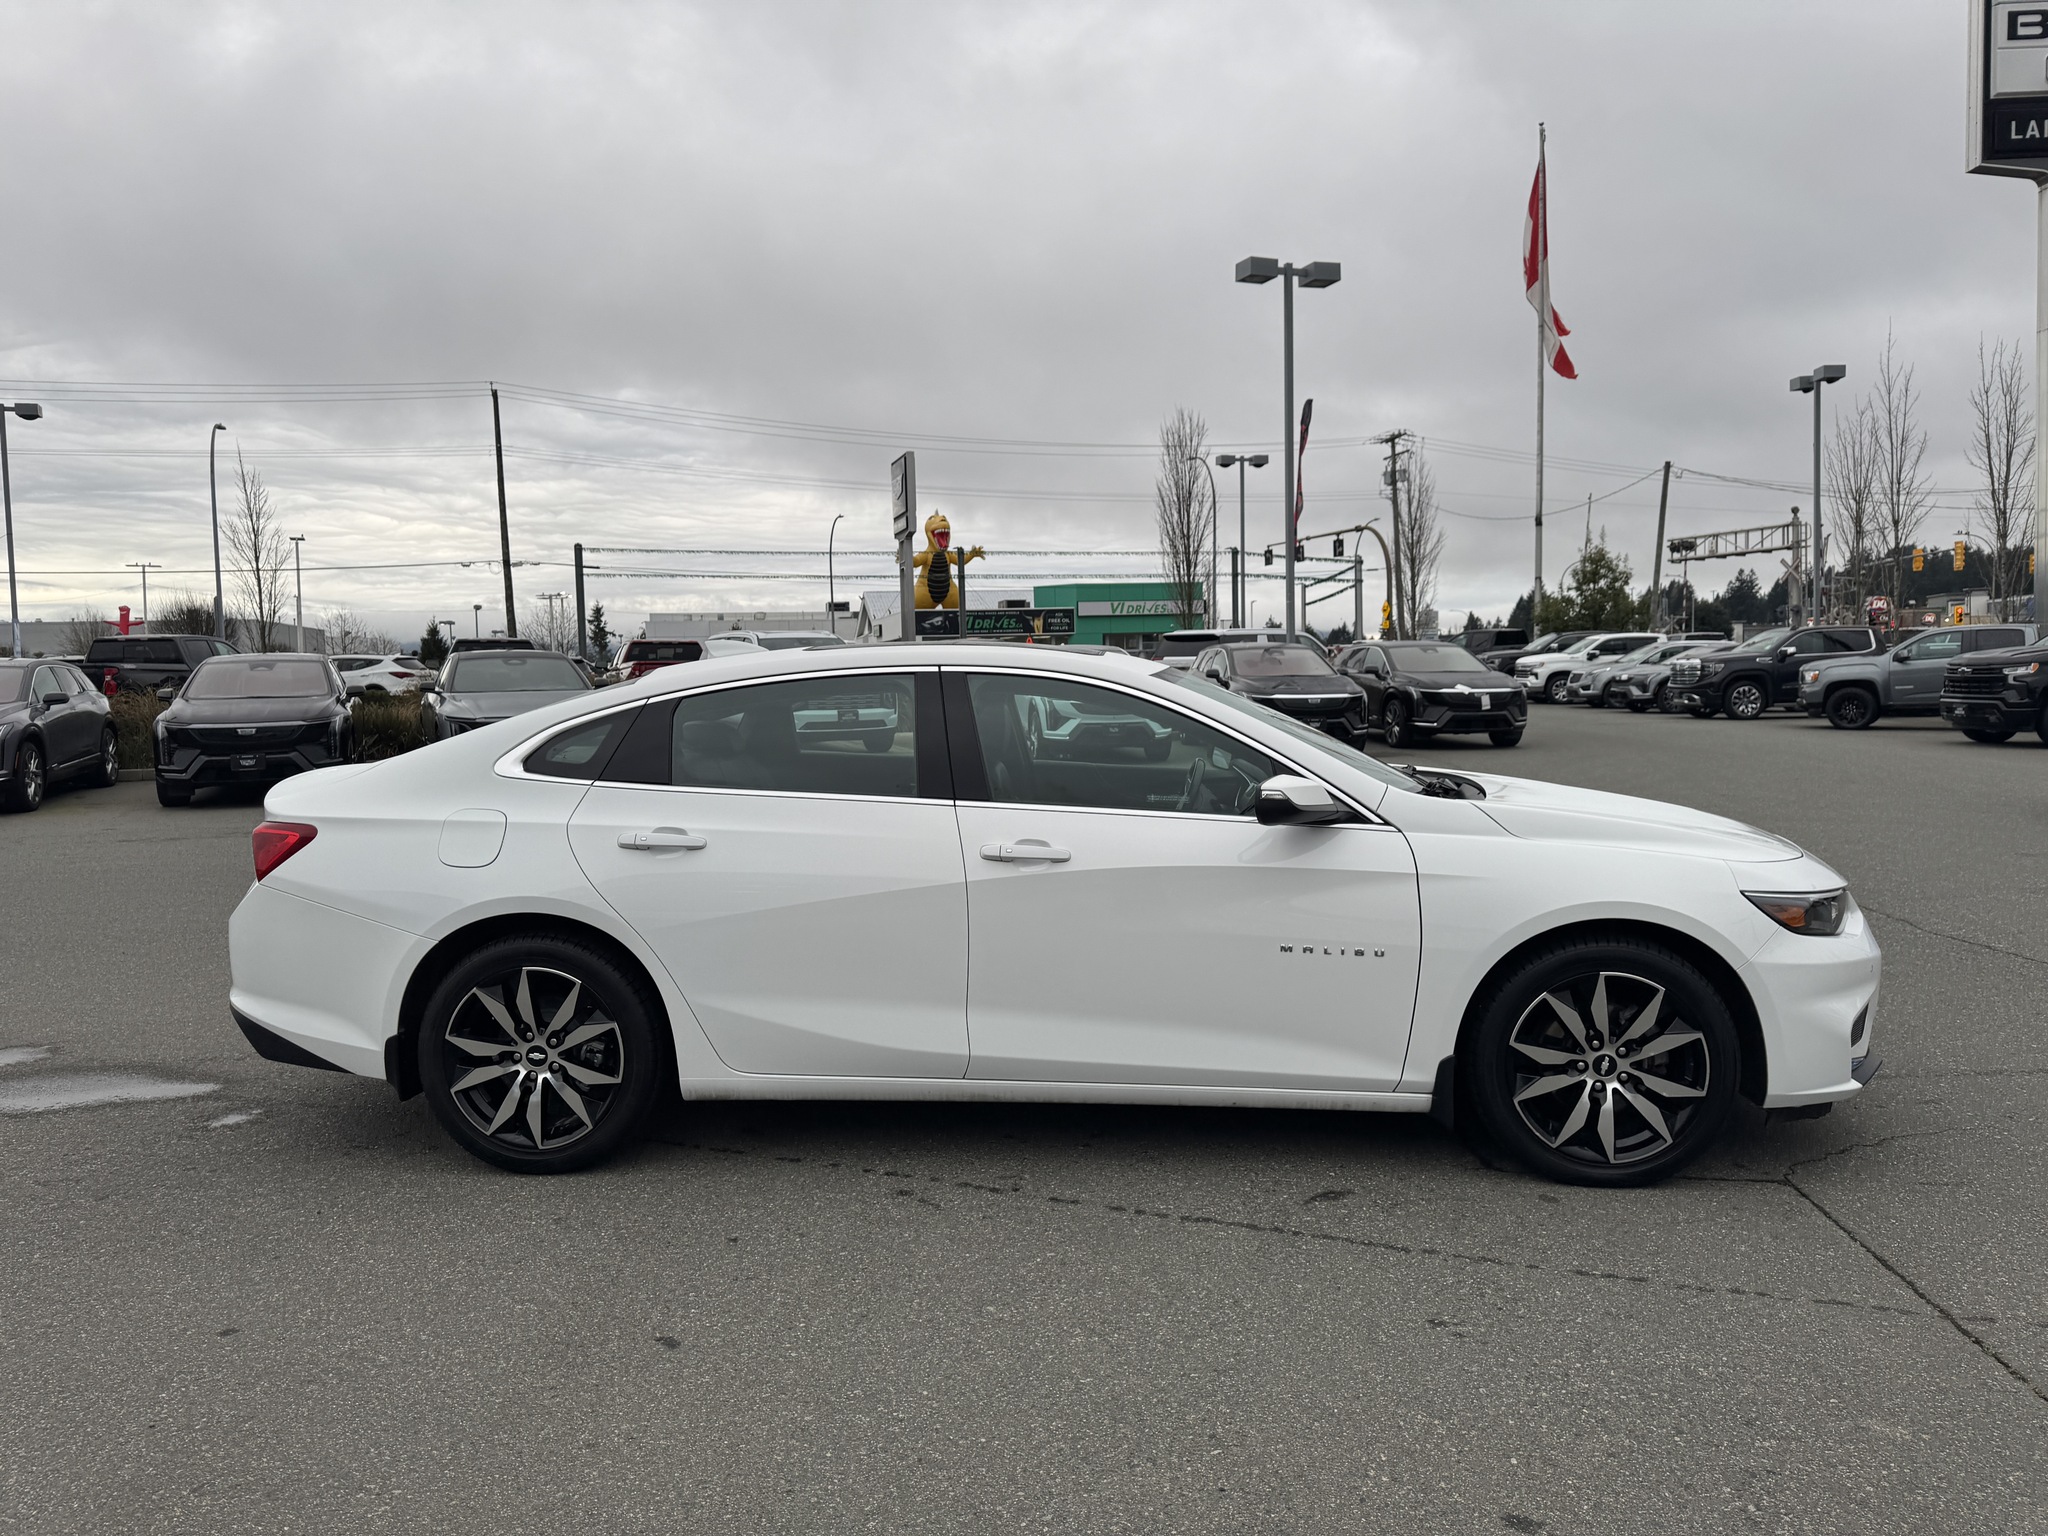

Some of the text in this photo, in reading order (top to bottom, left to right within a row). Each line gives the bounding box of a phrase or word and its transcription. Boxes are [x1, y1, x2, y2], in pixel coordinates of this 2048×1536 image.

[1110, 602, 1125, 614] VI
[1873, 600, 1887, 608] DQ
[1280, 944, 1385, 958] MALIBU
